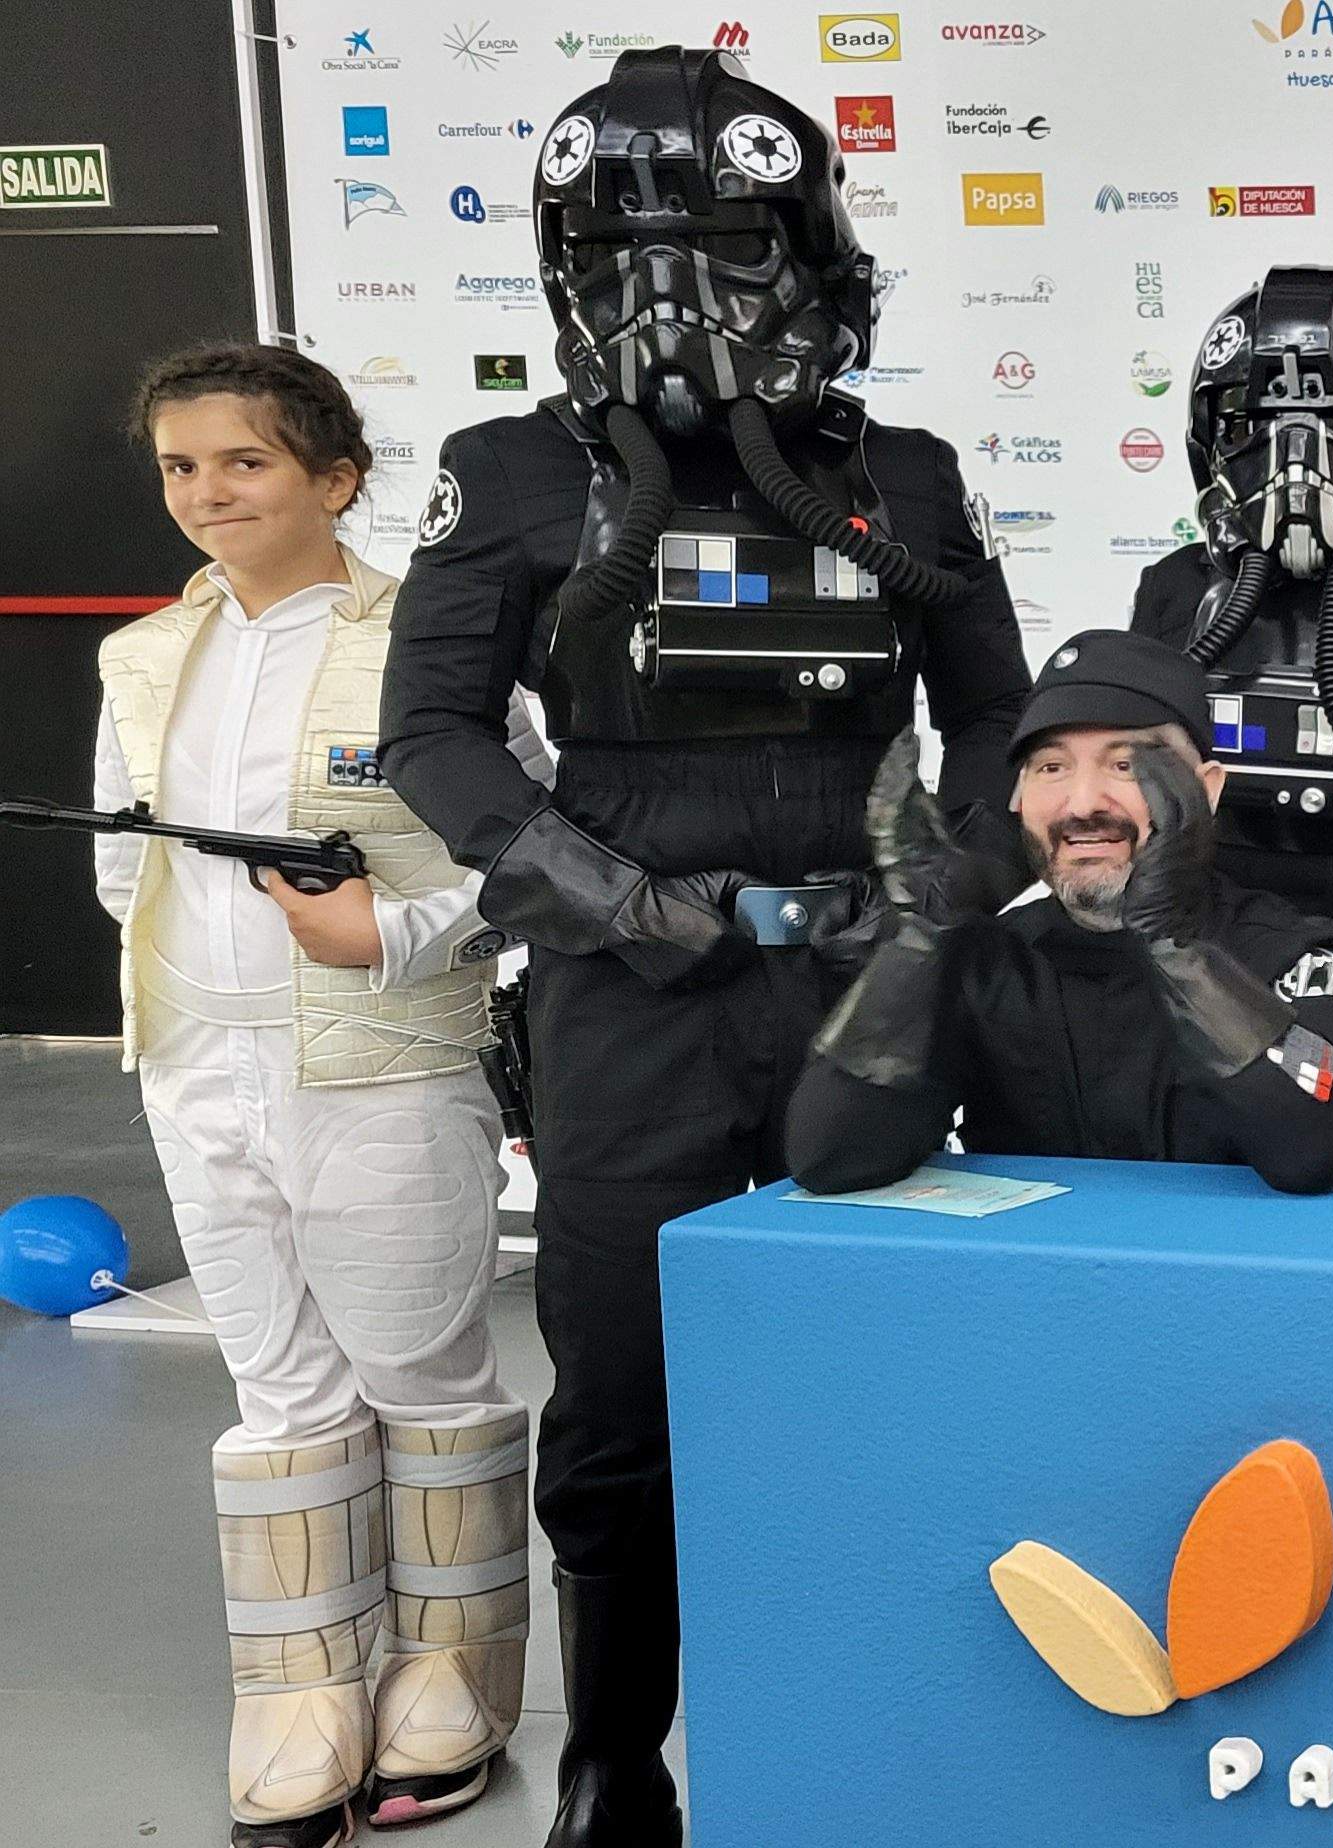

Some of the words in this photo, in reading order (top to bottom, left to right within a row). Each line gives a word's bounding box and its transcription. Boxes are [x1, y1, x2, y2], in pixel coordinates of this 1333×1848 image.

[832, 32, 890, 46] Bada
[941, 24, 1024, 41] avanza
[478, 39, 518, 50] EACRA
[587, 34, 655, 47] Fundación
[945, 103, 1007, 117] Fundación
[438, 122, 502, 138] Carrefour
[841, 123, 892, 141] Estrella
[1, 156, 103, 197] SALIDA
[971, 187, 1036, 216] Papsa
[1128, 191, 1179, 203] RIEGOS
[1243, 189, 1306, 201] DIPUTACIÓN
[1243, 203, 1259, 214] DE
[1260, 202, 1304, 213] HUESCA
[337, 282, 416, 298] URBAN
[455, 273, 536, 293] Aggrego
[375, 445, 414, 458] renas
[1013, 448, 1062, 463] ALÓS
